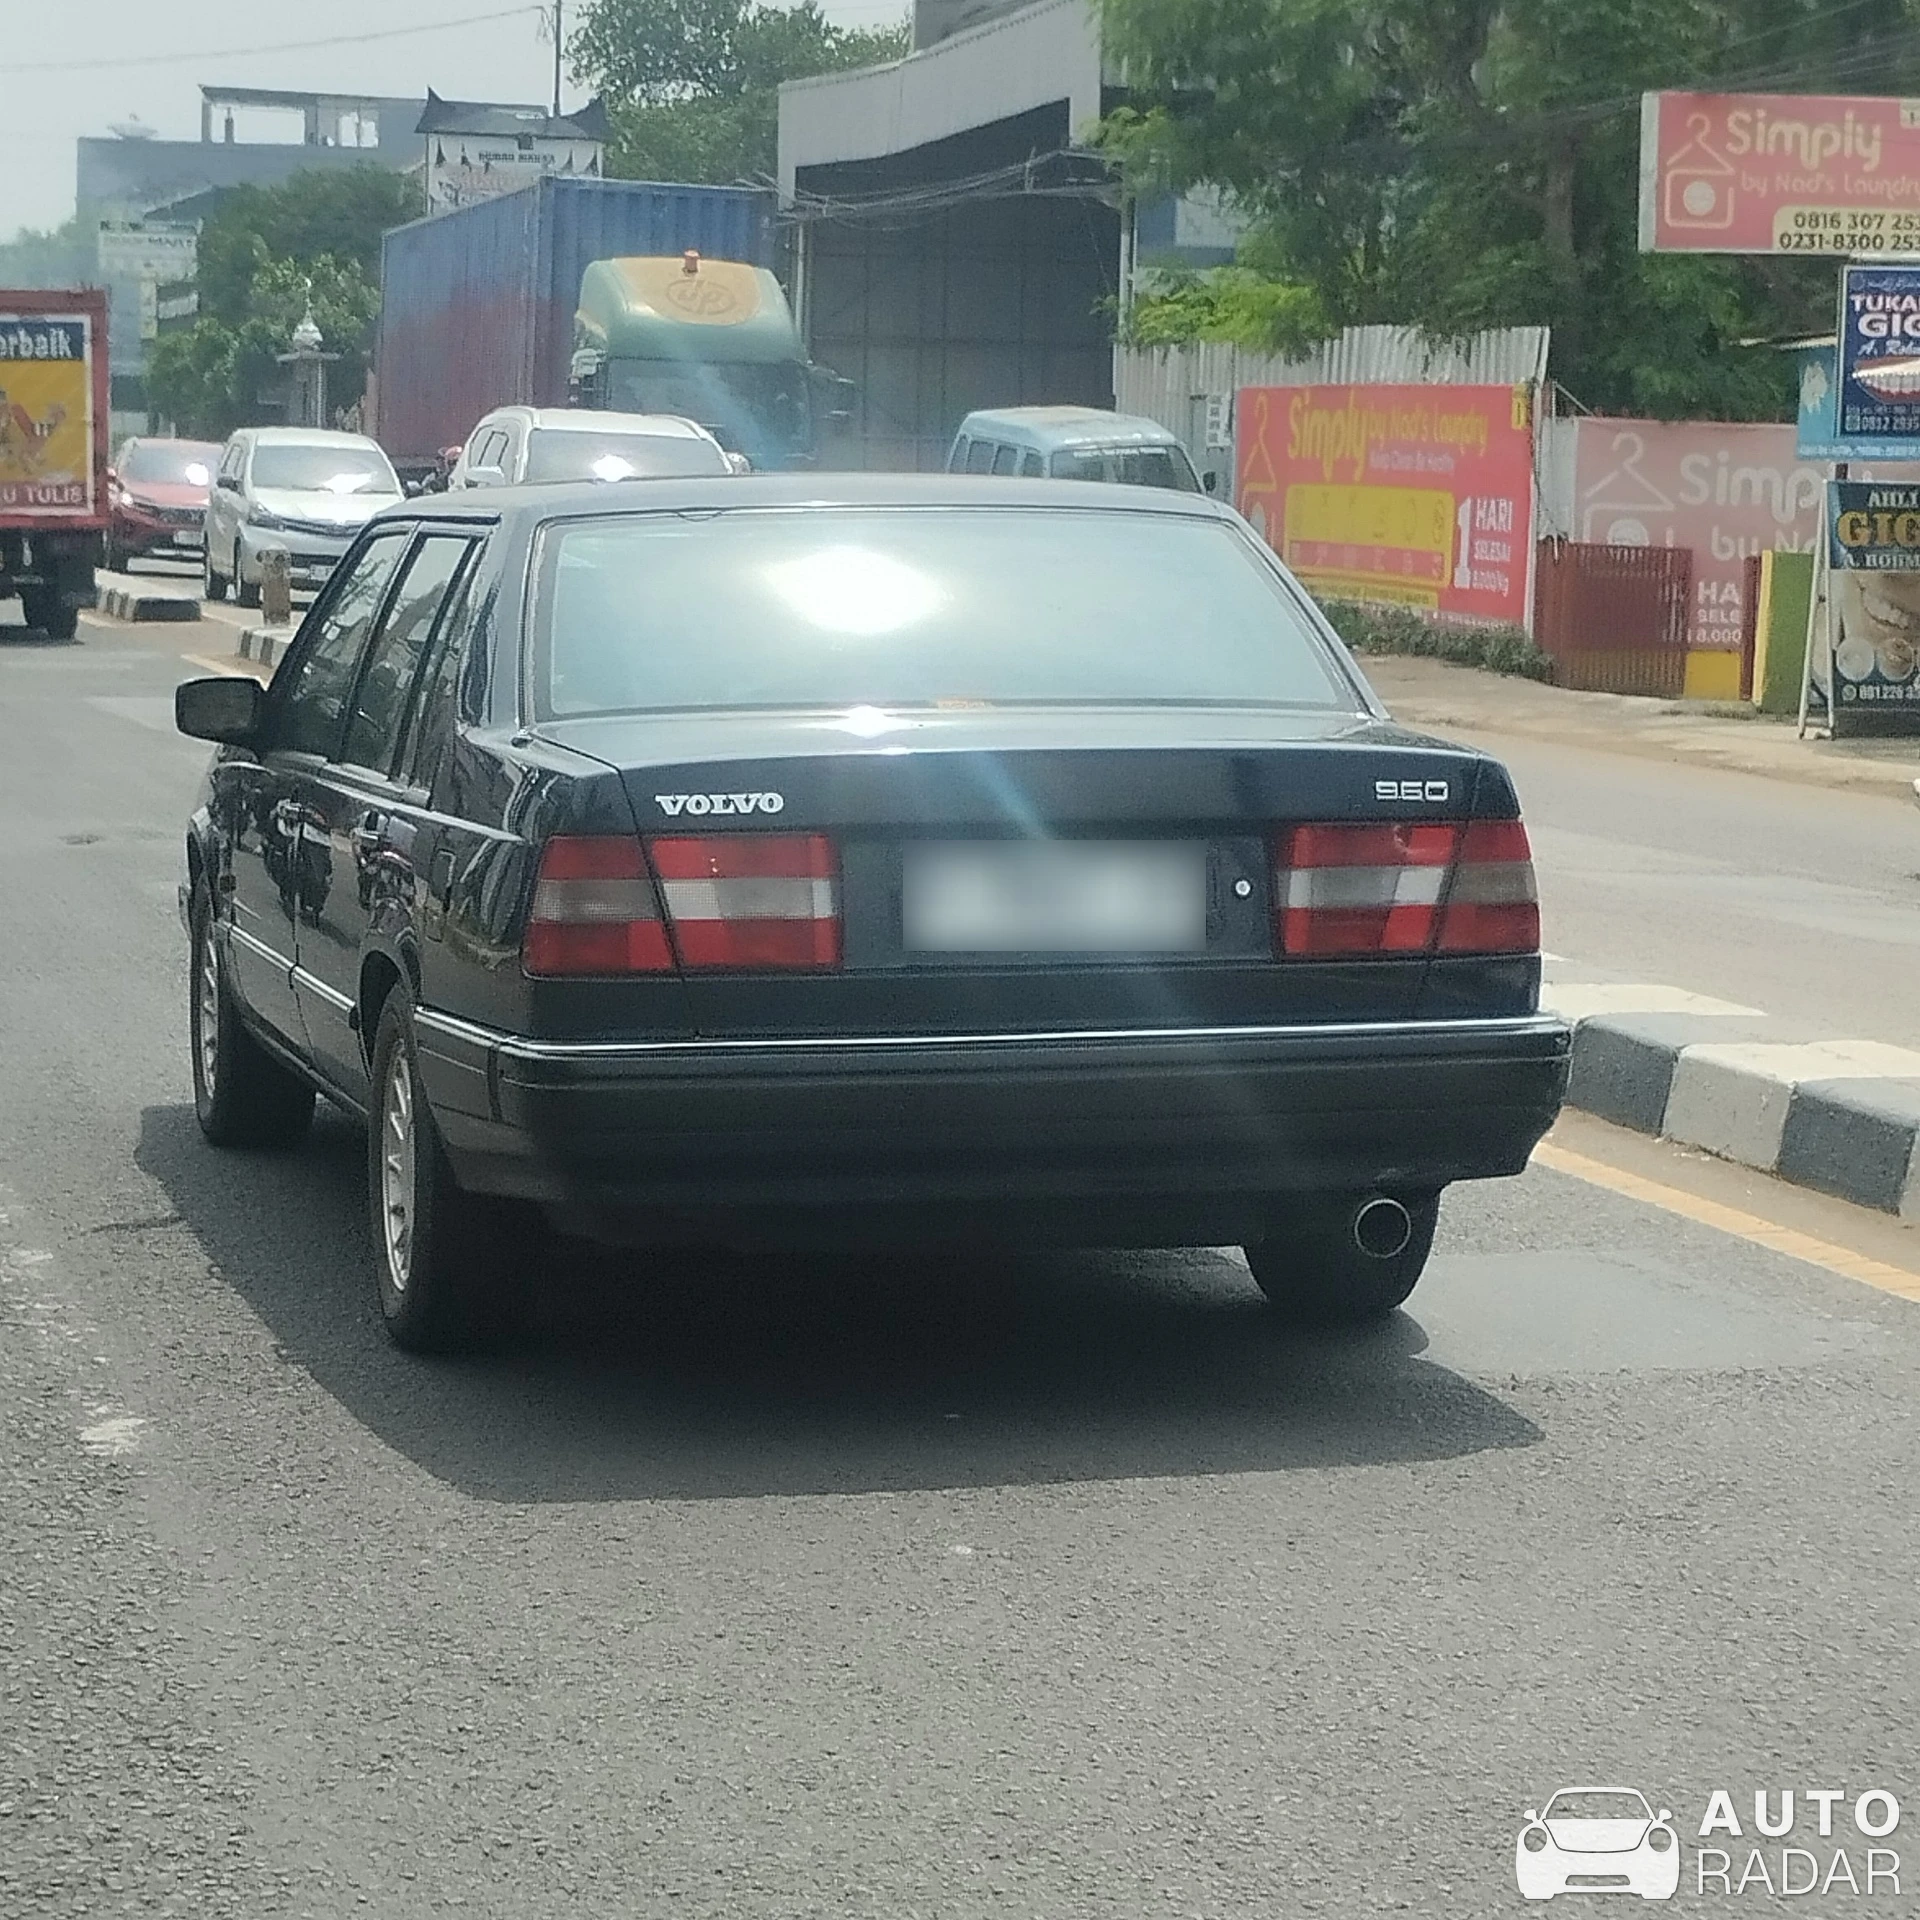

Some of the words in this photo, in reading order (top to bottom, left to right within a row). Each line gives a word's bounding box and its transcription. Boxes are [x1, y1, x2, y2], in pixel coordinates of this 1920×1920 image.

[1726, 108, 1881, 172] Simply
[1741, 170, 1768, 198] by
[1775, 172, 1835, 194] Nad's
[1794, 212, 1841, 230] 0816
[1847, 213, 1885, 230] 307
[1780, 233, 1884, 251] 0231-8300
[1849, 293, 1920, 312] TUKA
[1287, 389, 1366, 482] Simply
[1474, 498, 1513, 533] HARI
[1697, 581, 1742, 606] HA
[1375, 780, 1449, 802] 960
[655, 792, 784, 815] VOLVO
